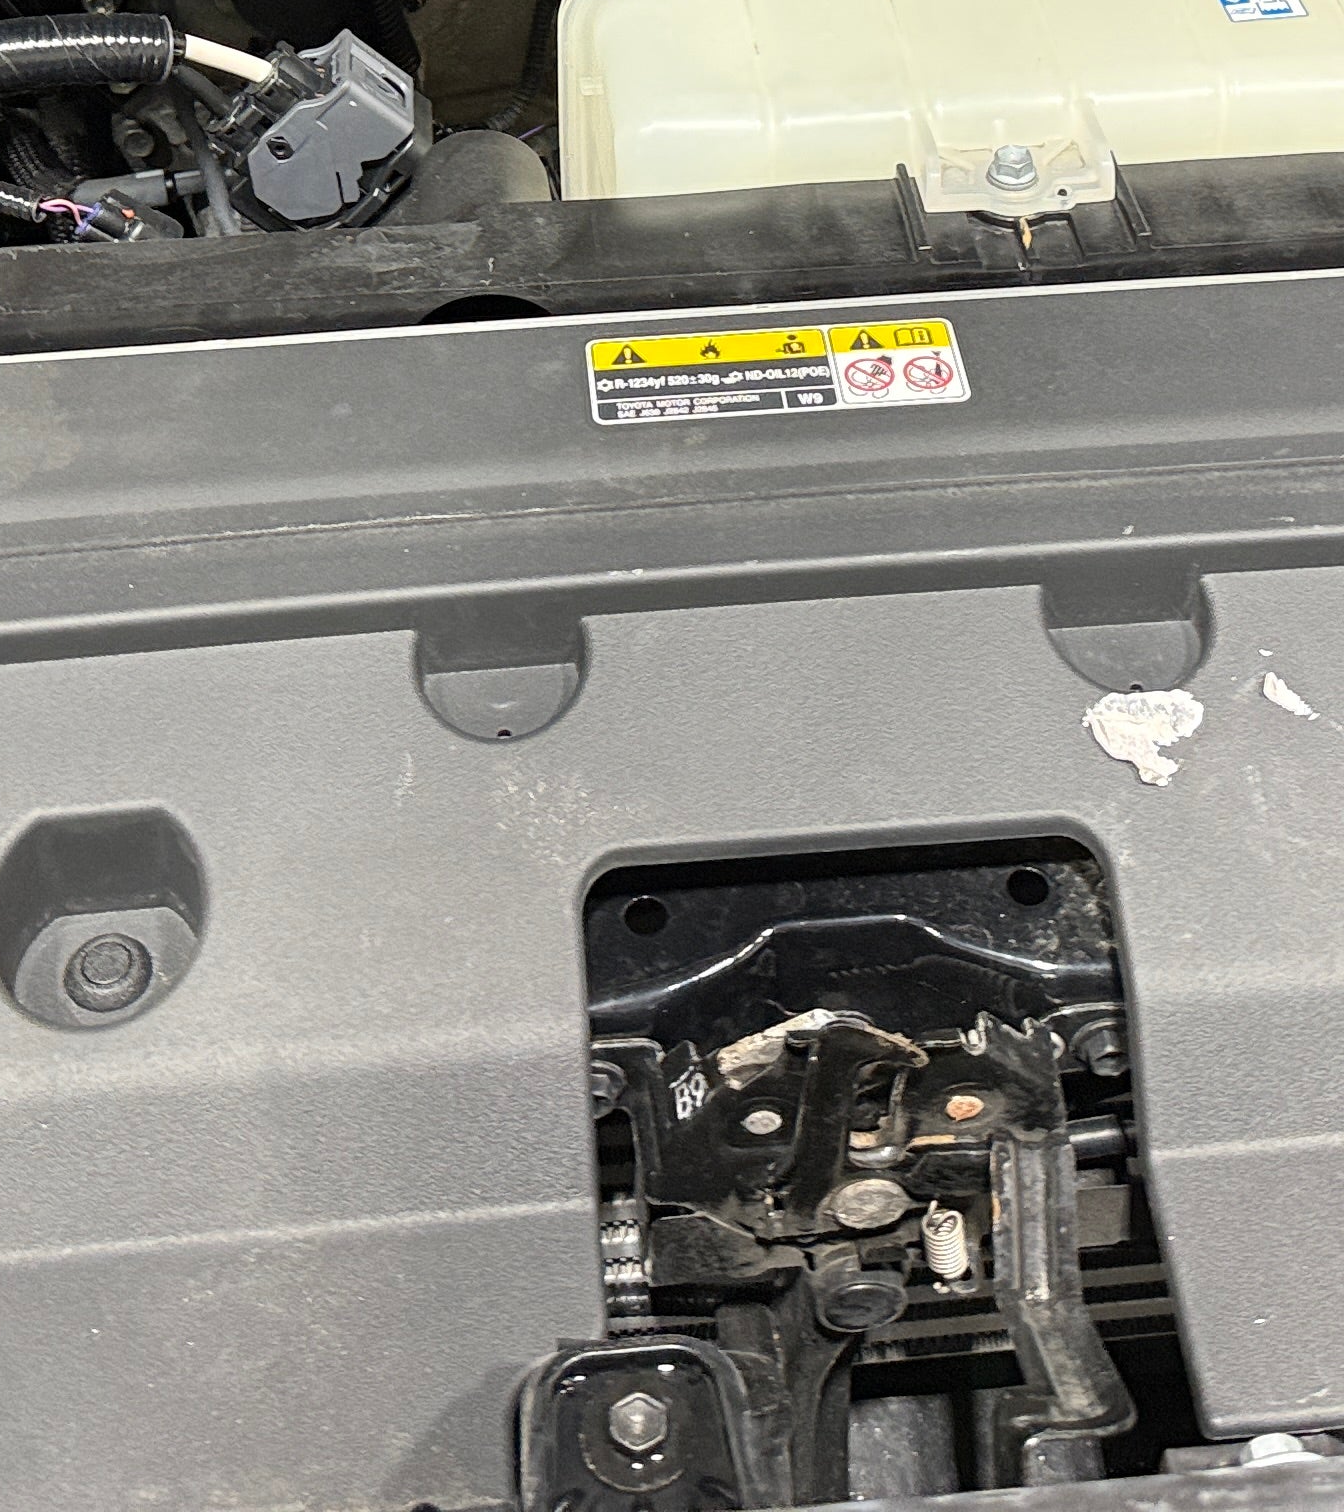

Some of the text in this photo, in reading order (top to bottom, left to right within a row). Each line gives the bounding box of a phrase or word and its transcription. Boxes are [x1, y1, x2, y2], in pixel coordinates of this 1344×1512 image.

[616, 394, 761, 411] TOYOTA MOTOR CORPORATION
[797, 392, 824, 405] W9
